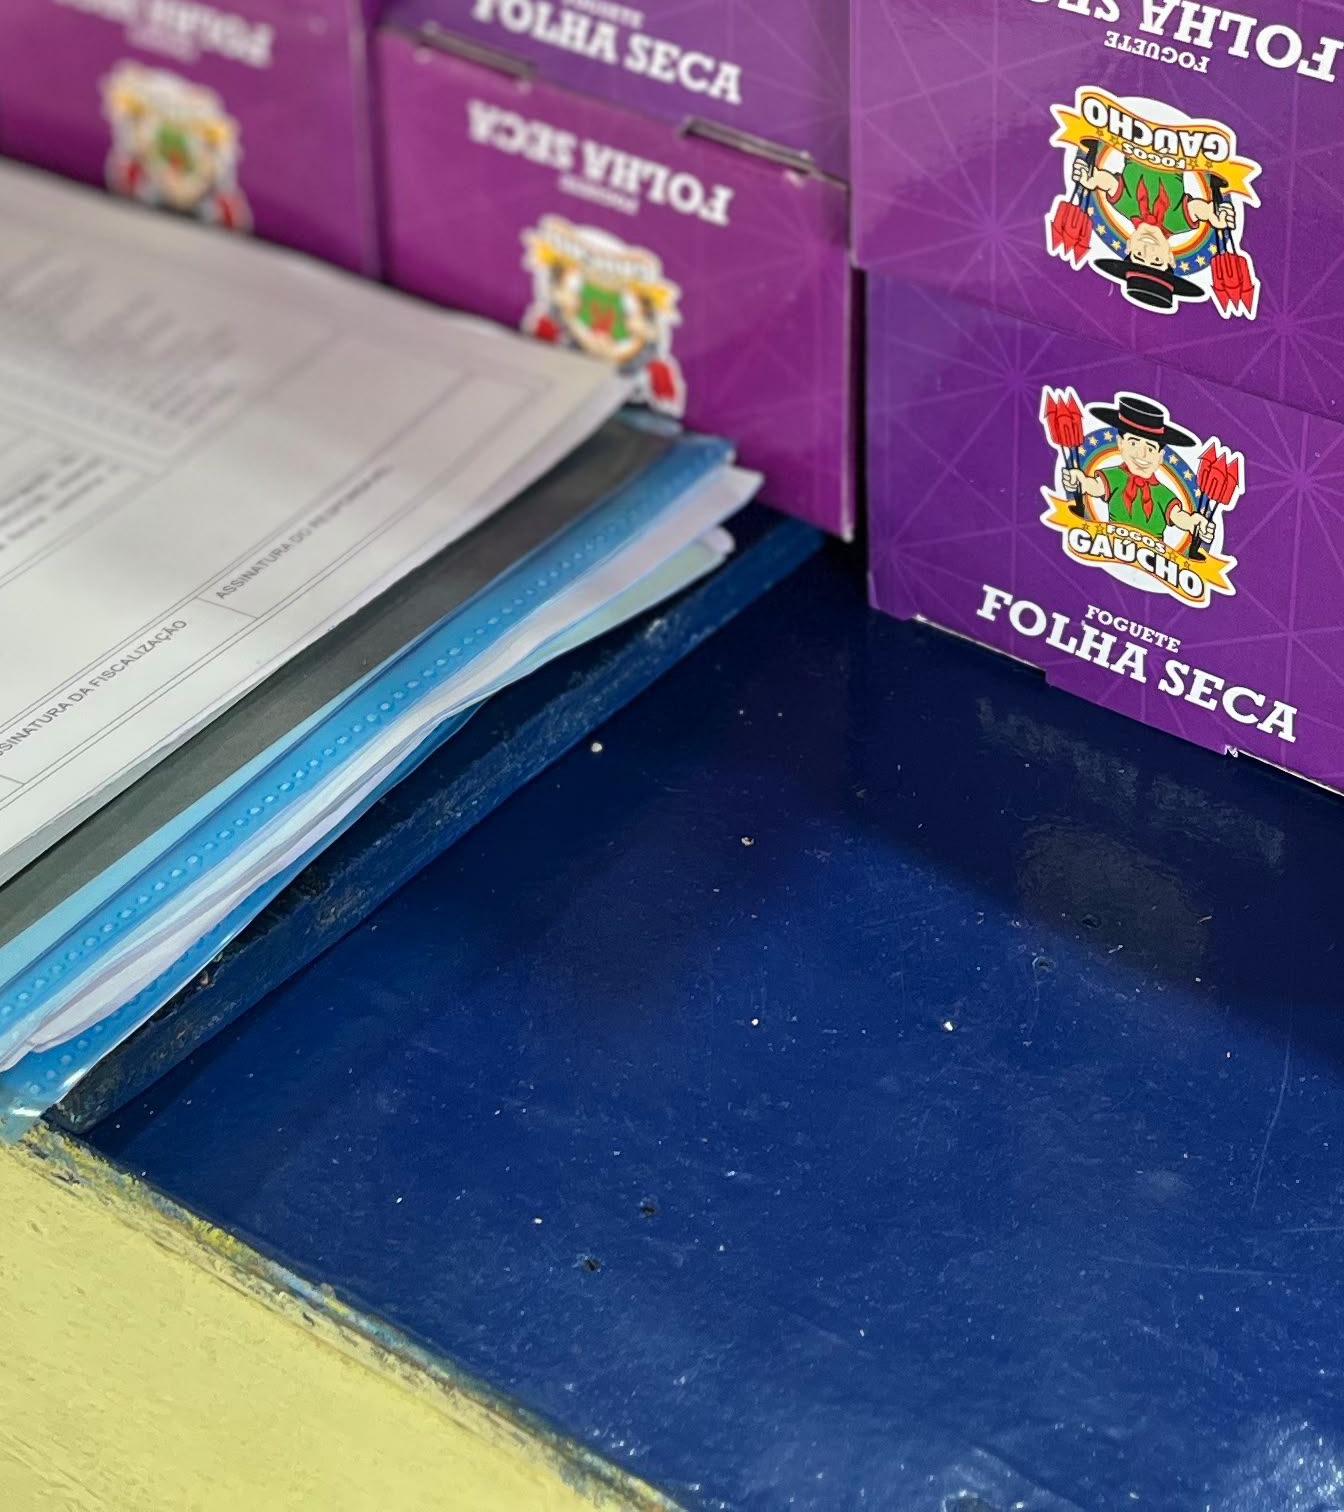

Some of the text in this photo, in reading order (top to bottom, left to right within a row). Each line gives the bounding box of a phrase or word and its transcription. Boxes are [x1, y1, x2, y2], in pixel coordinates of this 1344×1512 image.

[625, 31, 743, 105] SECA
[1104, 30, 1211, 74] FOGUETE
[467, 100, 576, 173] SECA
[1082, 95, 1231, 162] GAÚCHO
[1121, 142, 1188, 170] FOGOS
[583, 139, 735, 226] FOLHA
[1067, 526, 1205, 599] GAÚCHO
[1106, 523, 1166, 554] FOGOS
[66, 687, 95, 702] DA
[87, 619, 188, 687] FISCALIZAÇÃO
[975, 584, 1297, 743] FOLHA SECA
[1084, 604, 1182, 653] FOGUETE
